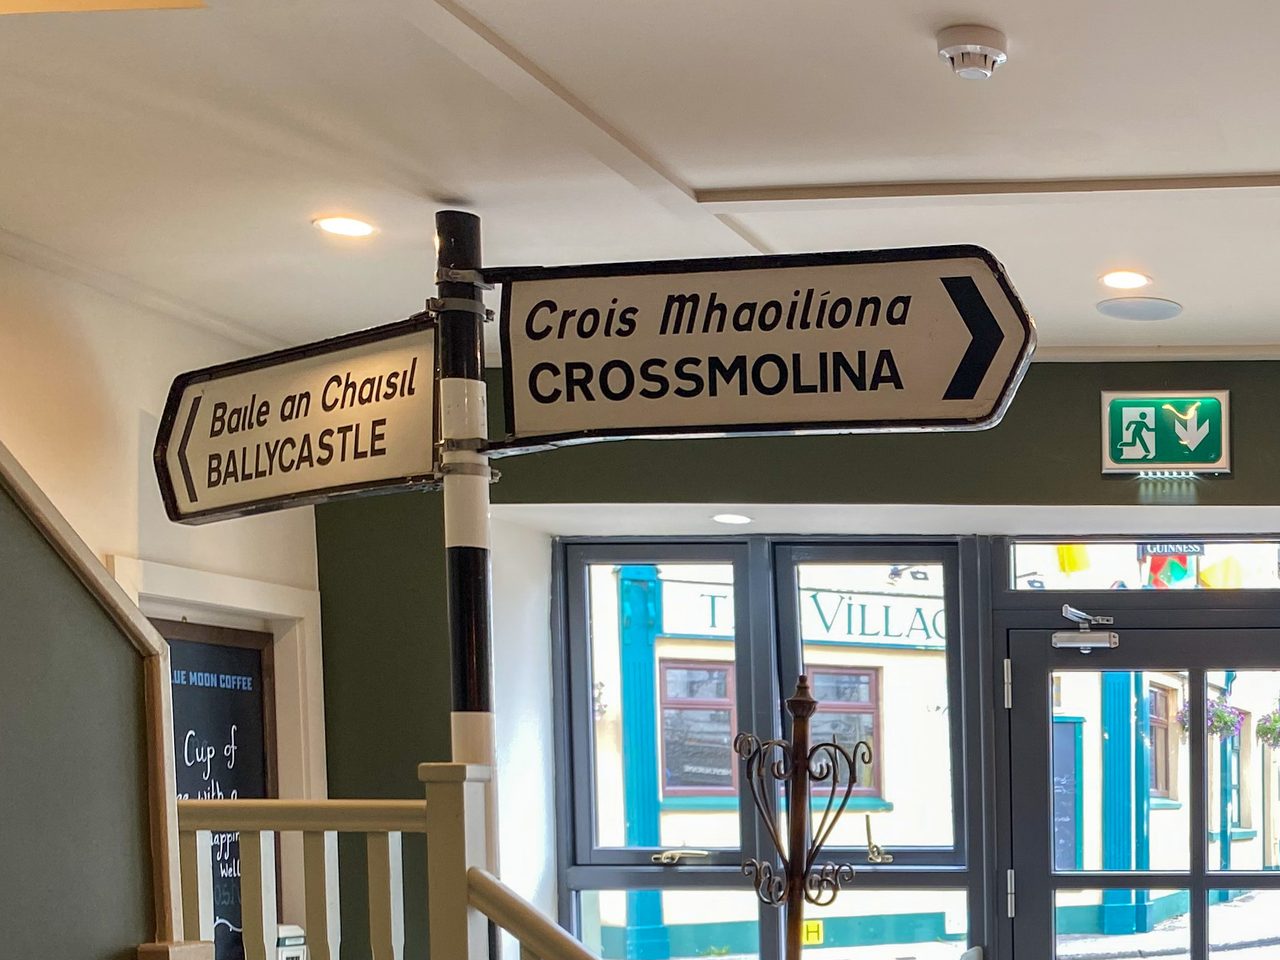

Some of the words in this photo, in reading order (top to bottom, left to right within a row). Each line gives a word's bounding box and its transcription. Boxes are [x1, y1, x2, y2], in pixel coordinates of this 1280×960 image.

[525, 298, 638, 341] Crois
[659, 288, 912, 336] Mhaoilíona
[209, 394, 270, 438] Baile
[280, 390, 311, 422] an
[321, 357, 418, 412] Chaisil
[528, 349, 904, 404] CROSSMOLINA
[207, 418, 387, 489] BALLYCASTLE
[1146, 543, 1201, 553] GUINNESS
[700, 594, 735, 629] T
[171, 669, 187, 685] UE
[189, 670, 218, 688] MOON
[219, 674, 253, 691] COFFEE
[184, 729, 215, 780] Cup
[224, 724, 238, 769] of
[805, 923, 820, 942] H
